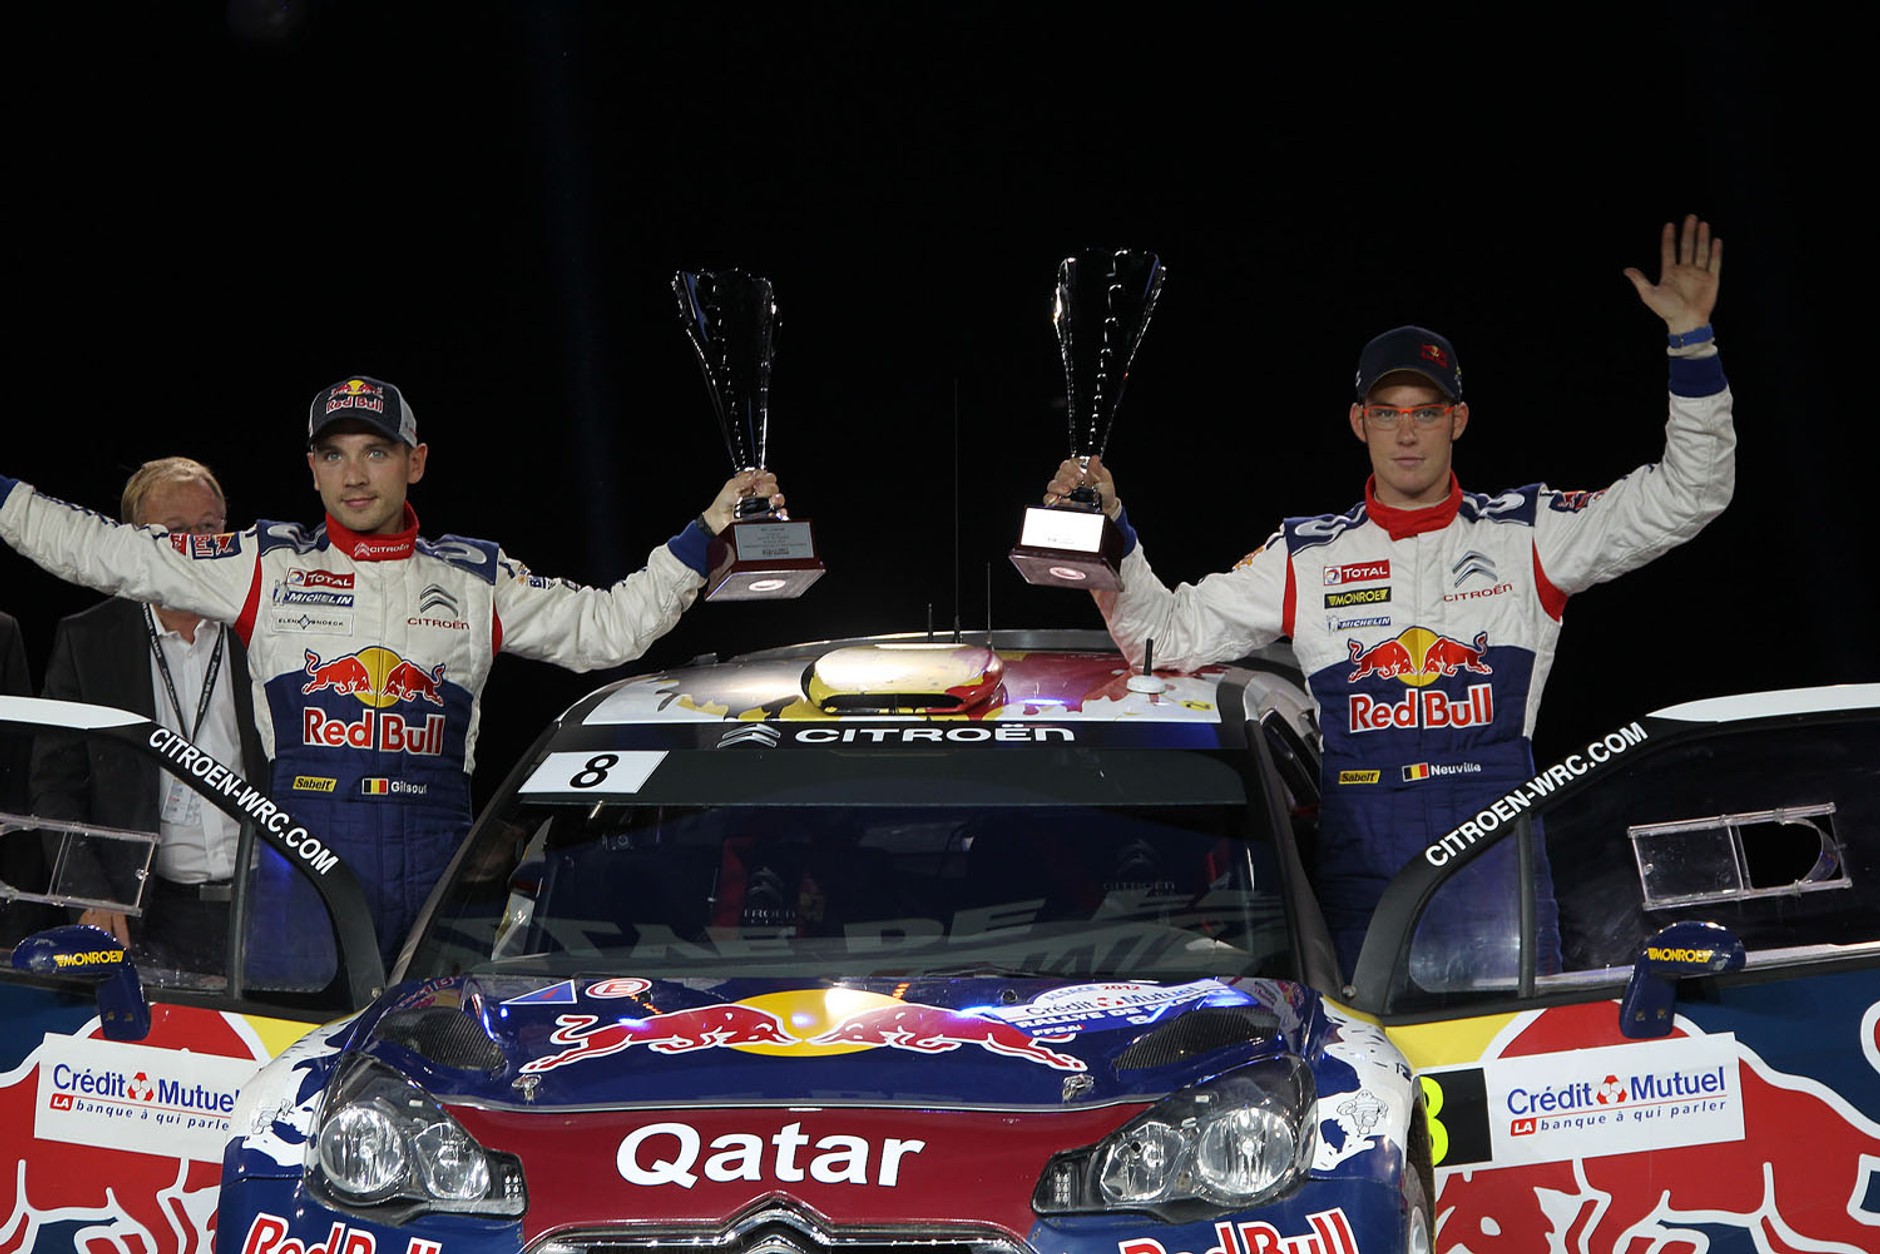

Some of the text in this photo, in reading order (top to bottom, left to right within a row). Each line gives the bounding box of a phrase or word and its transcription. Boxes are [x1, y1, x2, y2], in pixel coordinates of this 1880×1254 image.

[326, 396, 384, 414] Red Bull
[307, 573, 352, 587] TOTAL
[1343, 566, 1388, 579] TOTAL
[289, 590, 353, 605] MICHELIN
[1334, 589, 1382, 606] MONROE
[1341, 616, 1390, 630] MICHELIN
[1349, 682, 1494, 734] Red Bull
[303, 706, 446, 757] Red Bull
[569, 753, 620, 790] 8
[1341, 771, 1375, 783] Sabelt
[1431, 761, 1482, 776] Neuville
[295, 777, 333, 792] Sabelt
[1425, 721, 1649, 868] CITROEN-WRC.COM
[149, 727, 340, 876] CITROEN-WRC.COM
[64, 950, 120, 967] MONROE
[1656, 948, 1709, 963] MONROE
[603, 982, 634, 994] E
[1025, 985, 1201, 1015] Crédit Mutuel
[1015, 1010, 1106, 1029] RALLYE
[1107, 1006, 1142, 1017] DE
[53, 1063, 126, 1099] Crédit
[1507, 1066, 1726, 1115] Crédit Mutuel
[53, 1097, 69, 1109] LA
[76, 1099, 133, 1118] banque
[140, 1110, 149, 1120] à
[156, 1112, 182, 1126] qui
[1514, 1100, 1727, 1134] LA banque à qui parler
[615, 1121, 926, 1189] Qatar
